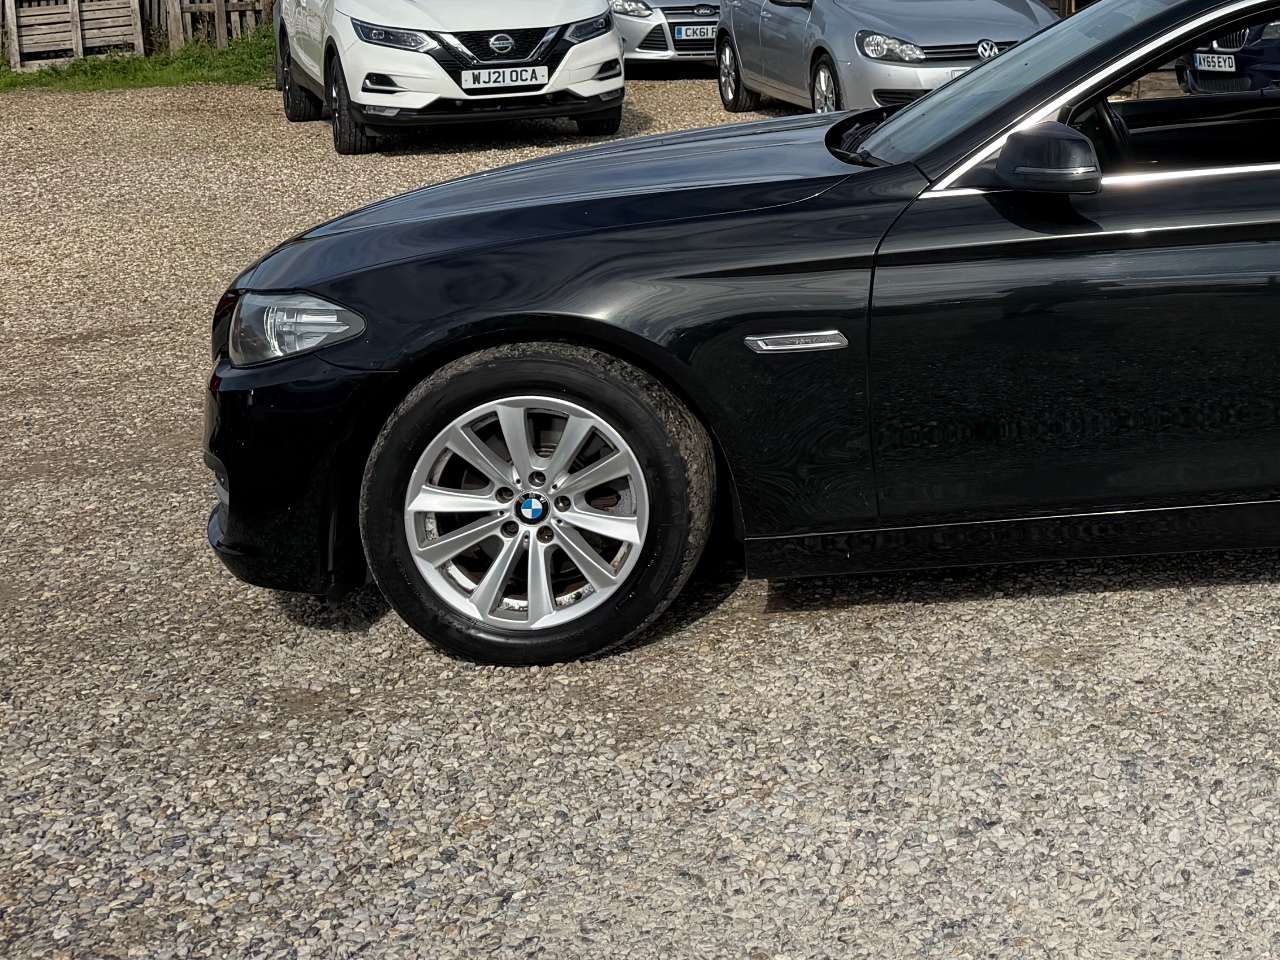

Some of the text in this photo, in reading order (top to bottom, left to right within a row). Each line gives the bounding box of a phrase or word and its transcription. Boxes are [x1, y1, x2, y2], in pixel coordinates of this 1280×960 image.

[685, 27, 708, 38] CK61
[1218, 56, 1234, 69] EYD
[472, 71, 506, 85] WJ21
